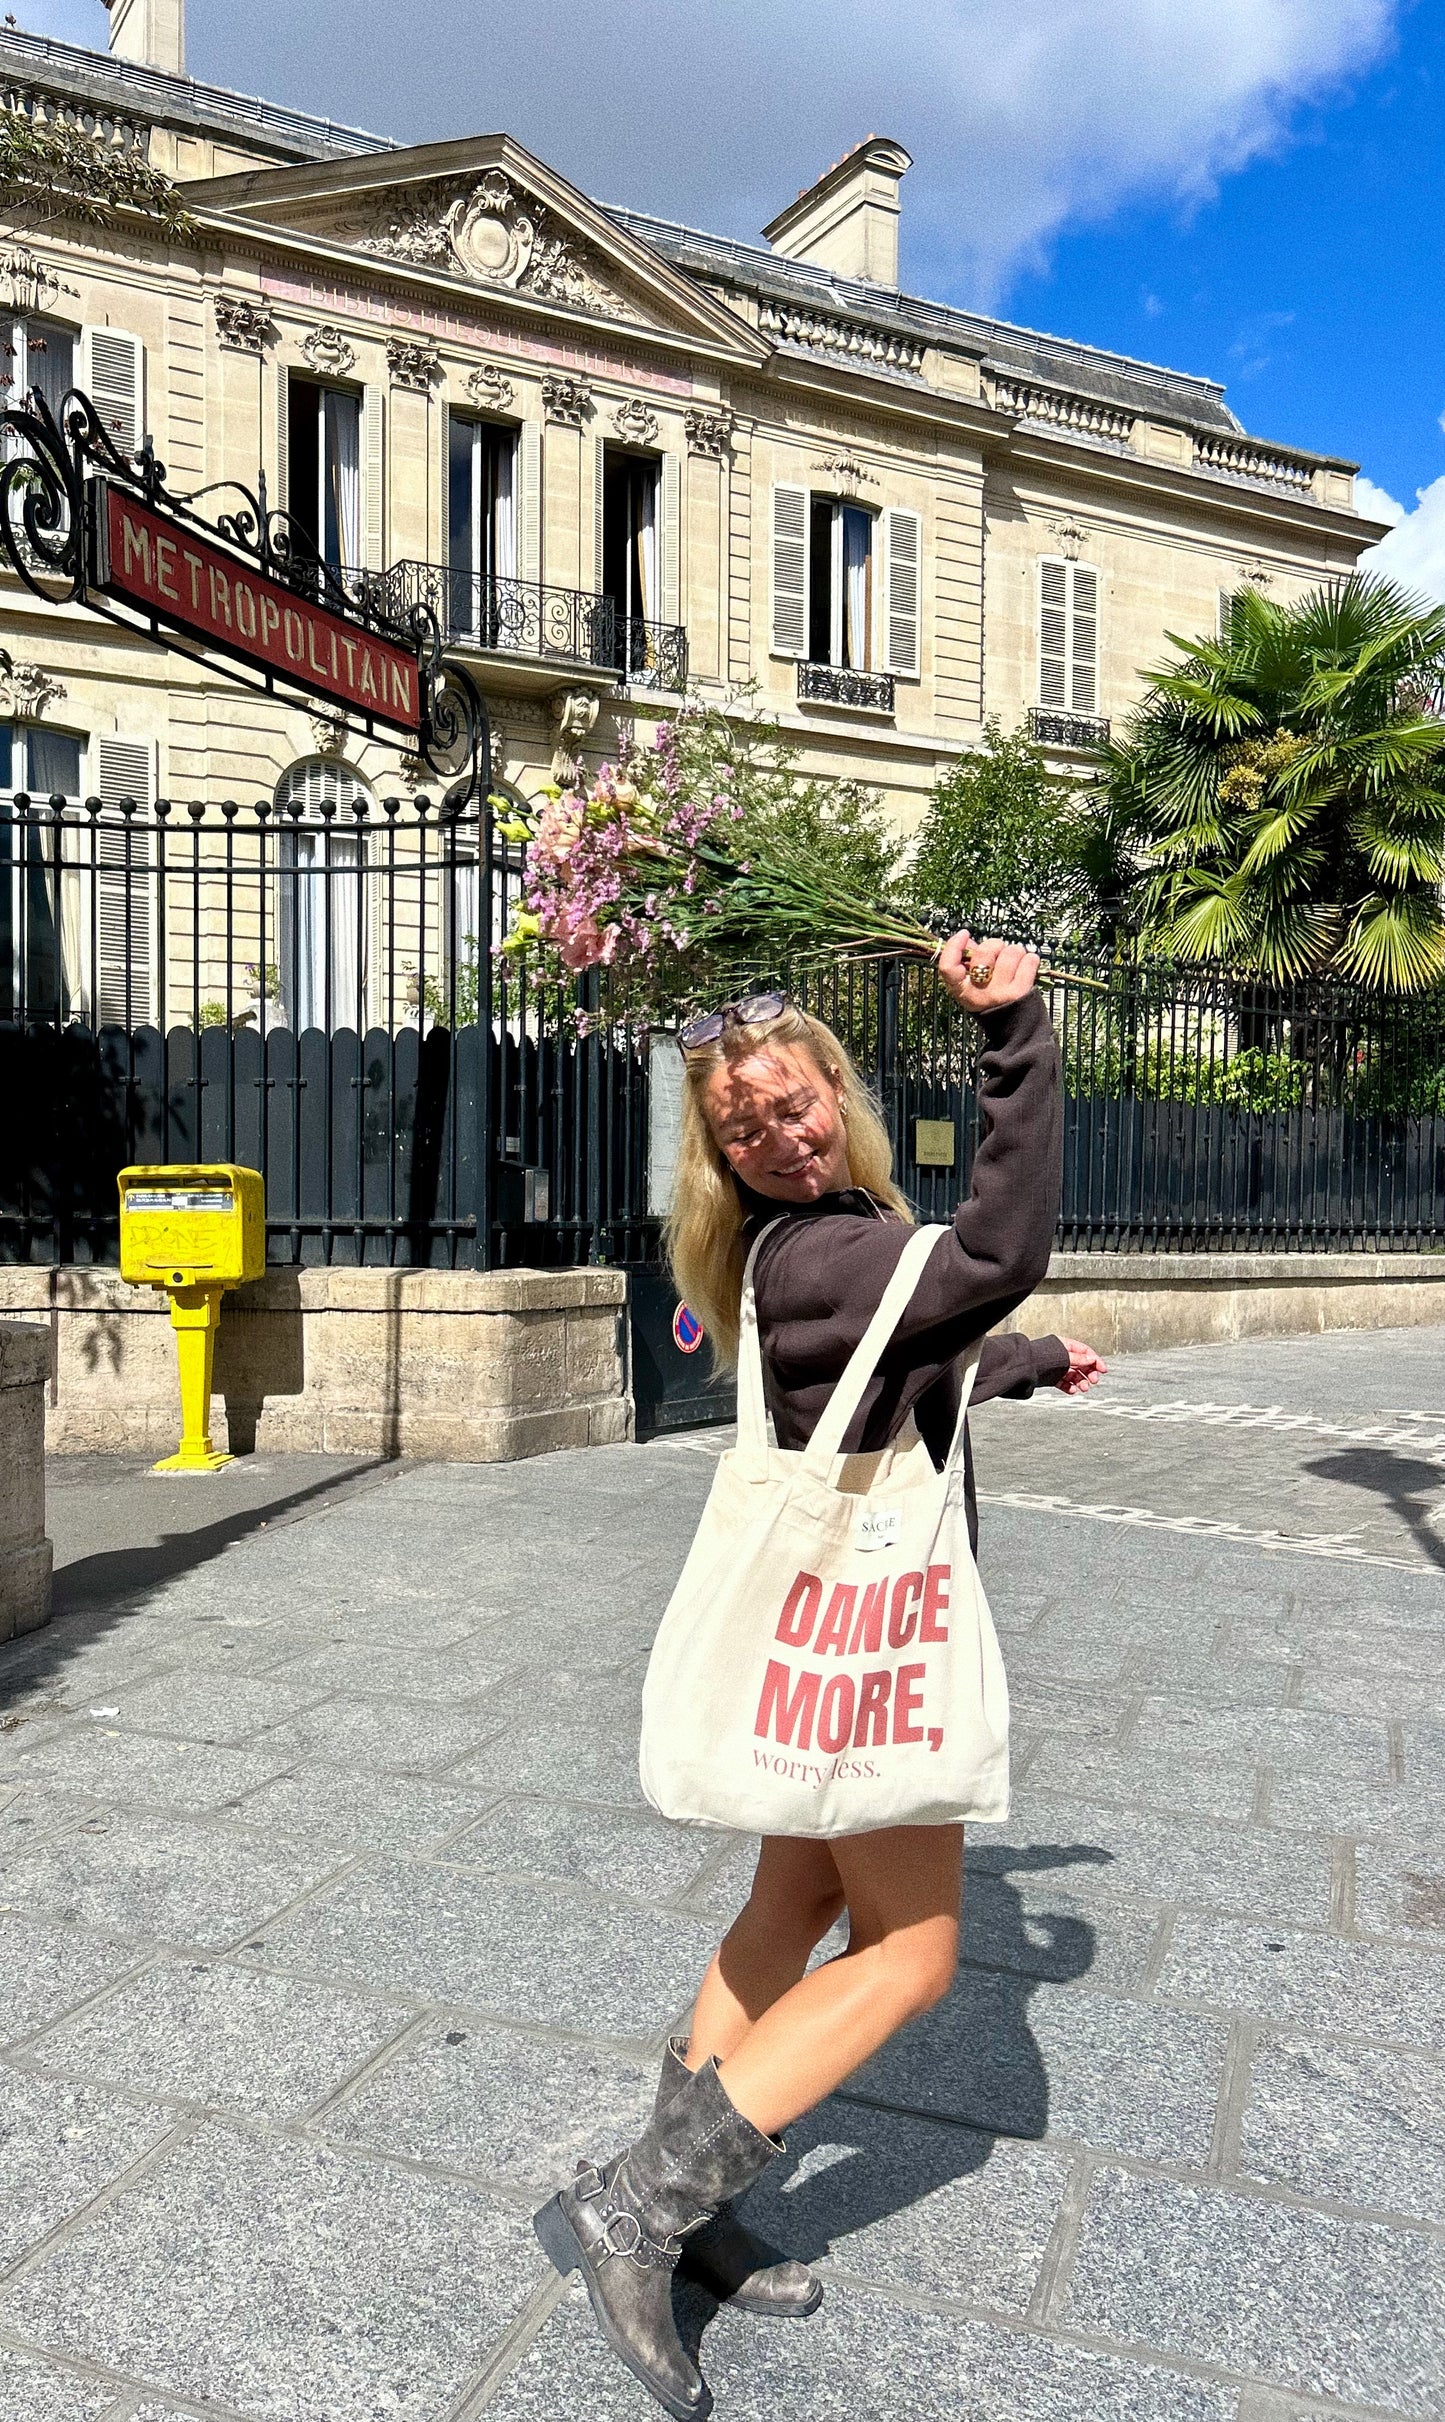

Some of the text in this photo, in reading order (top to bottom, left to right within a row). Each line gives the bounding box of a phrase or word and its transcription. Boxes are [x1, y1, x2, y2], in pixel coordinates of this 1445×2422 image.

[122, 513, 411, 713] METROPOLITAIN
[774, 1564, 952, 1657] DANCE
[753, 1658, 944, 1755] MORE,
[753, 1748, 882, 1790] worry less.
